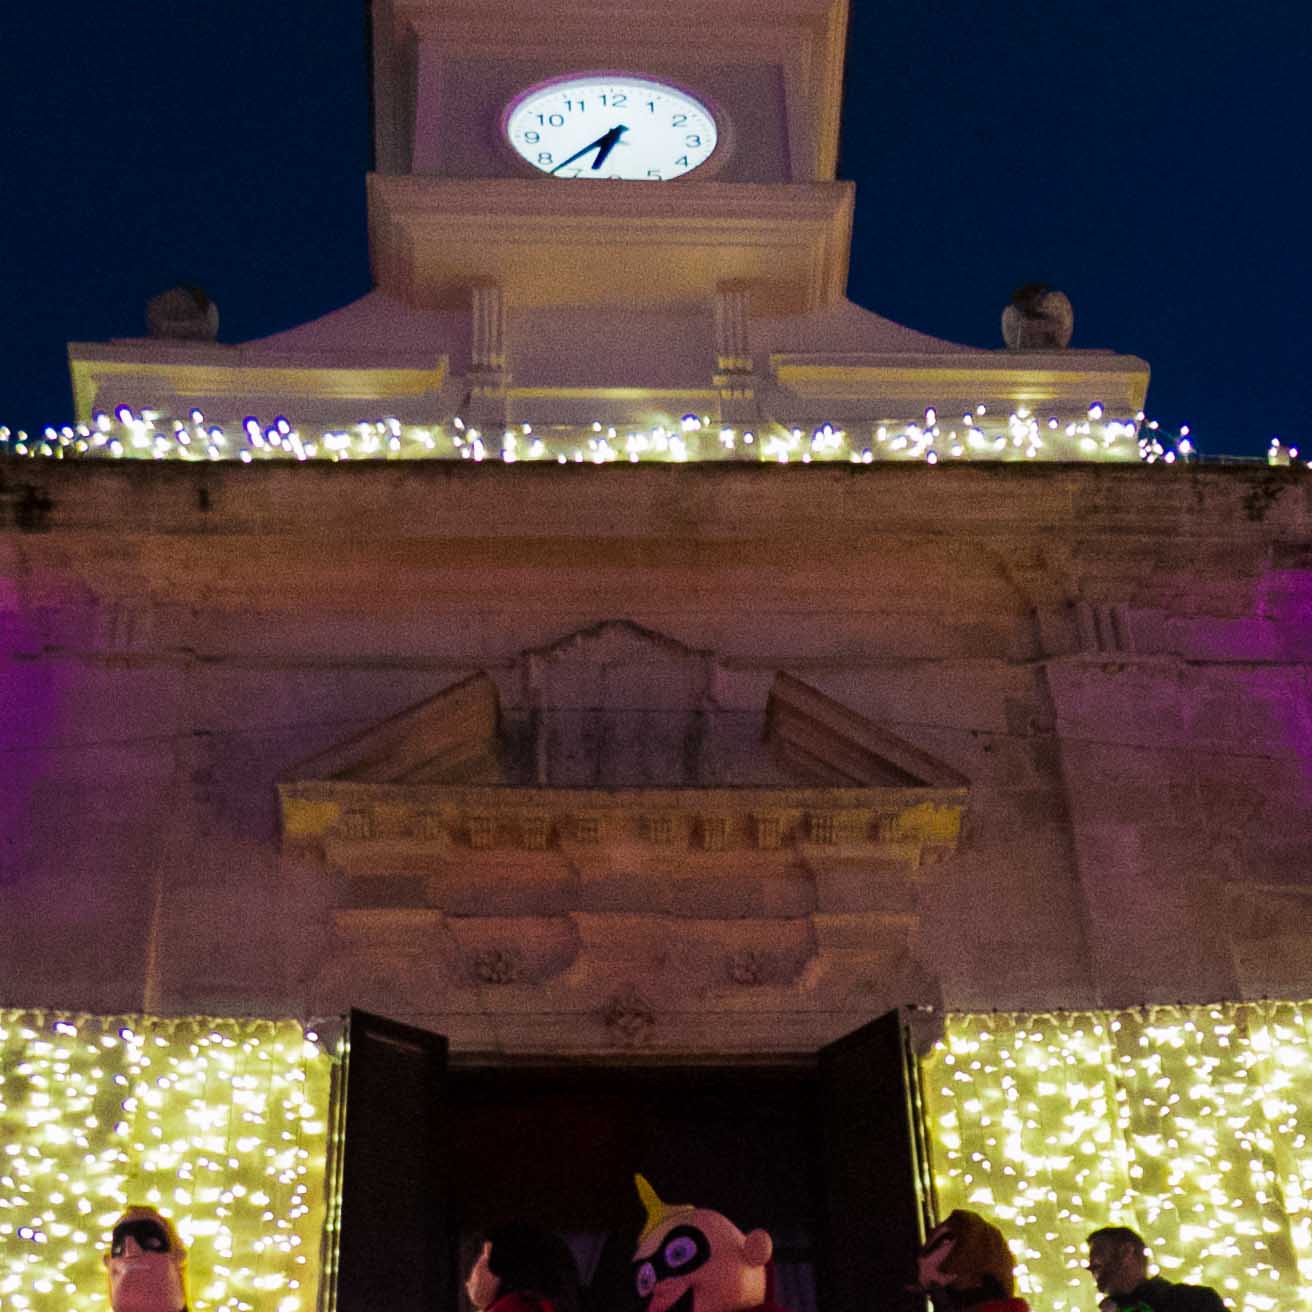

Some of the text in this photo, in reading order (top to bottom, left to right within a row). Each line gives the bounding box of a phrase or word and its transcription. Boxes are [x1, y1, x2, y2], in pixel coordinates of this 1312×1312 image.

[563, 100, 586, 112] 11
[599, 94, 628, 108] 12
[647, 101, 655, 113] 1
[536, 113, 565, 128] 10
[672, 114, 688, 127] 2
[524, 130, 541, 144] 9
[686, 134, 702, 148] 3
[537, 152, 554, 165] 8
[674, 155, 689, 168] 4
